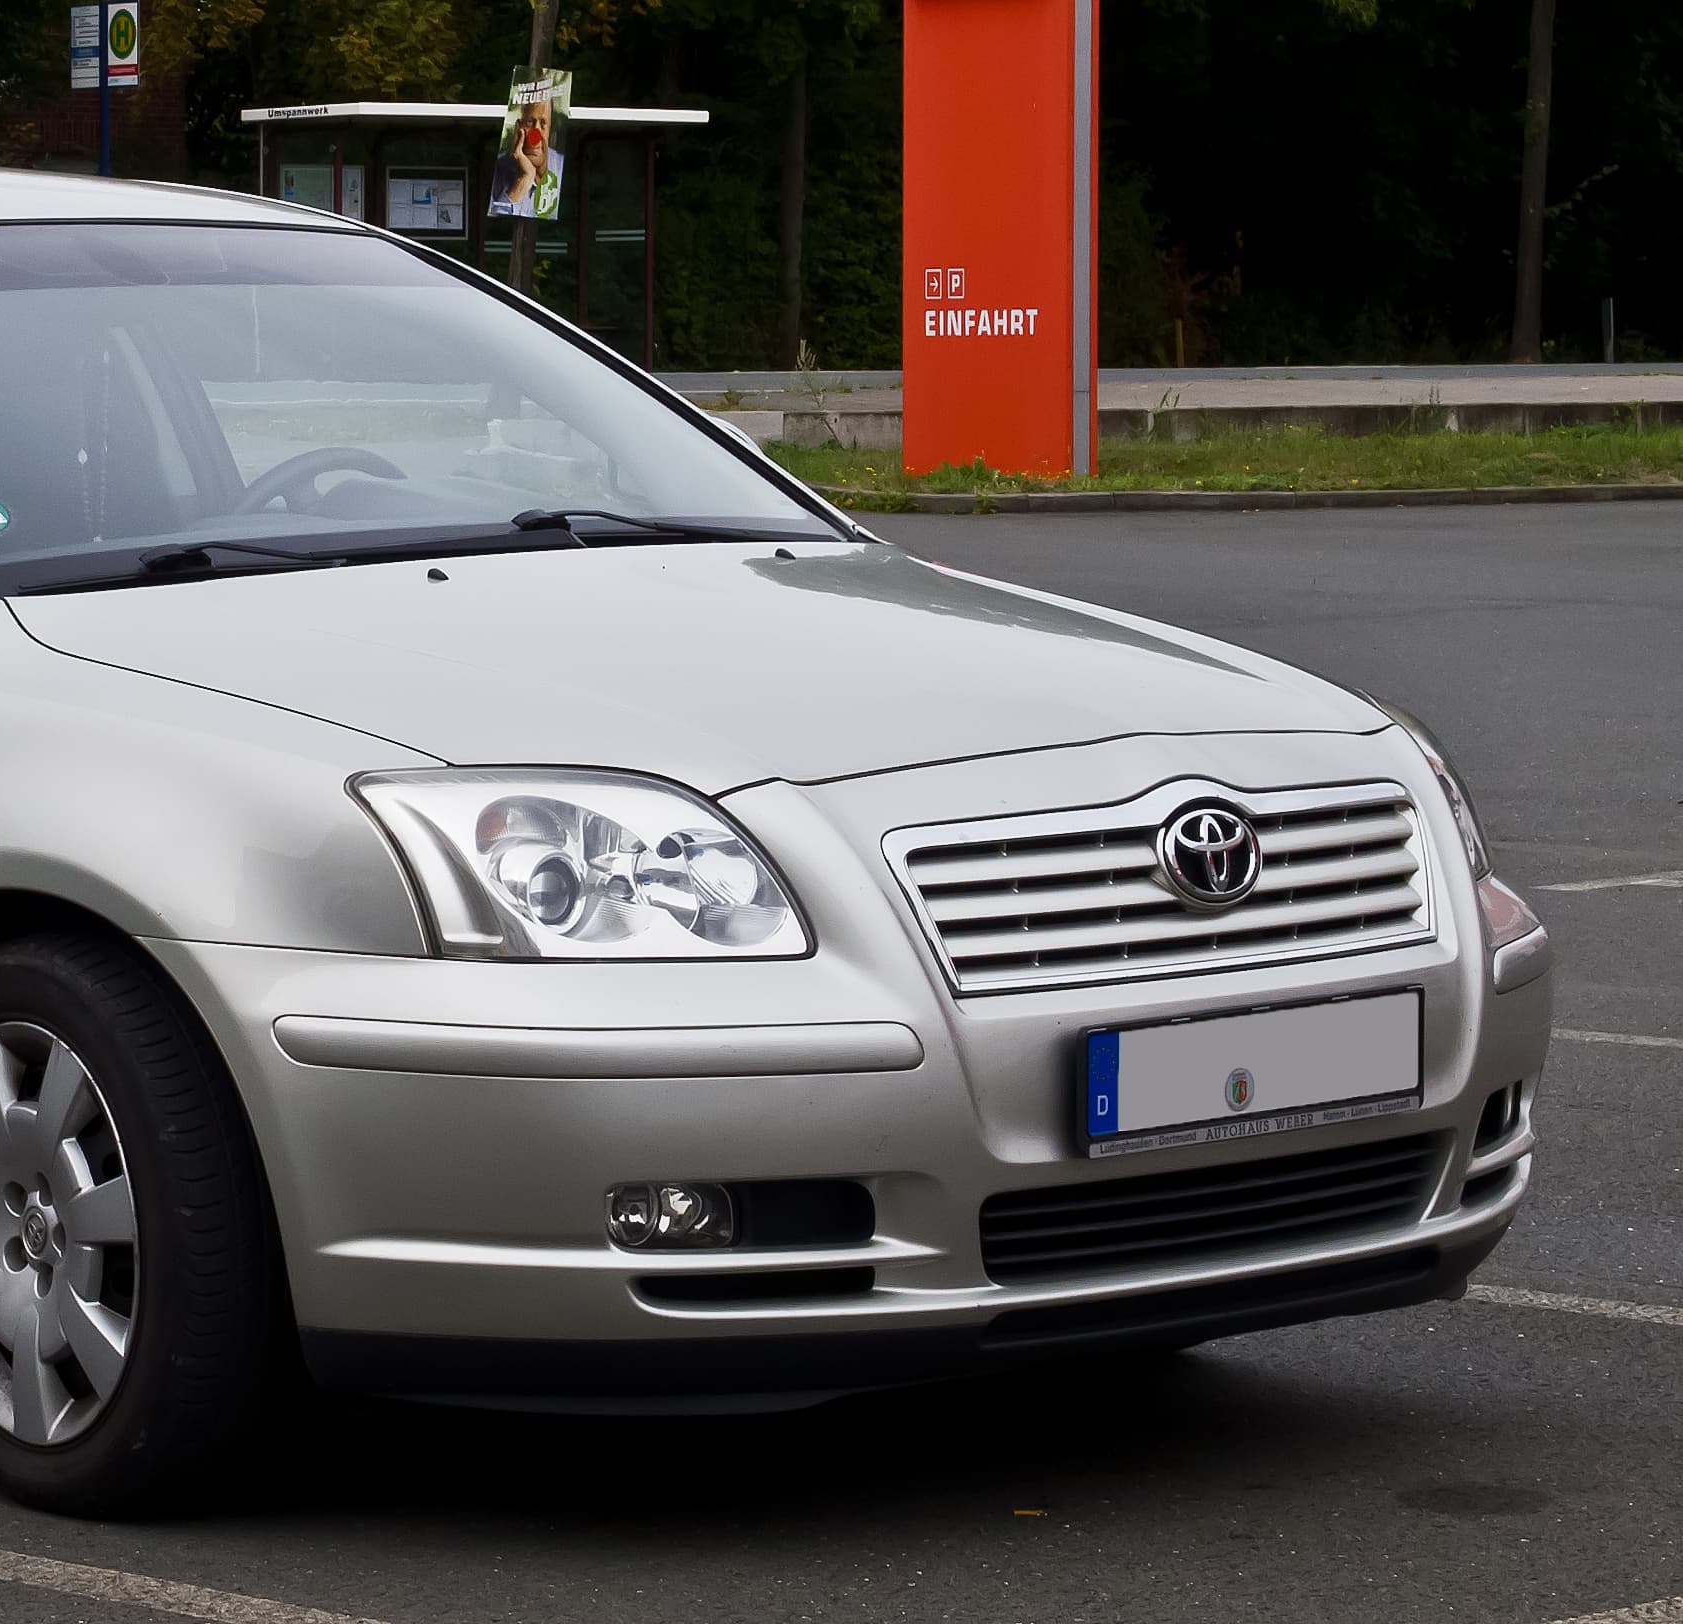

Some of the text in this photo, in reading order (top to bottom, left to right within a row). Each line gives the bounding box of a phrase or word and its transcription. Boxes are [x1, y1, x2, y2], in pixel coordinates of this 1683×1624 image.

[267, 106, 329, 119] Umspannwerk
[924, 308, 1039, 337] EINFAHRT
[1097, 1095, 1109, 1116] D
[1206, 1119, 1270, 1141] AUTOHAUS
[1274, 1113, 1314, 1130] WEBER
